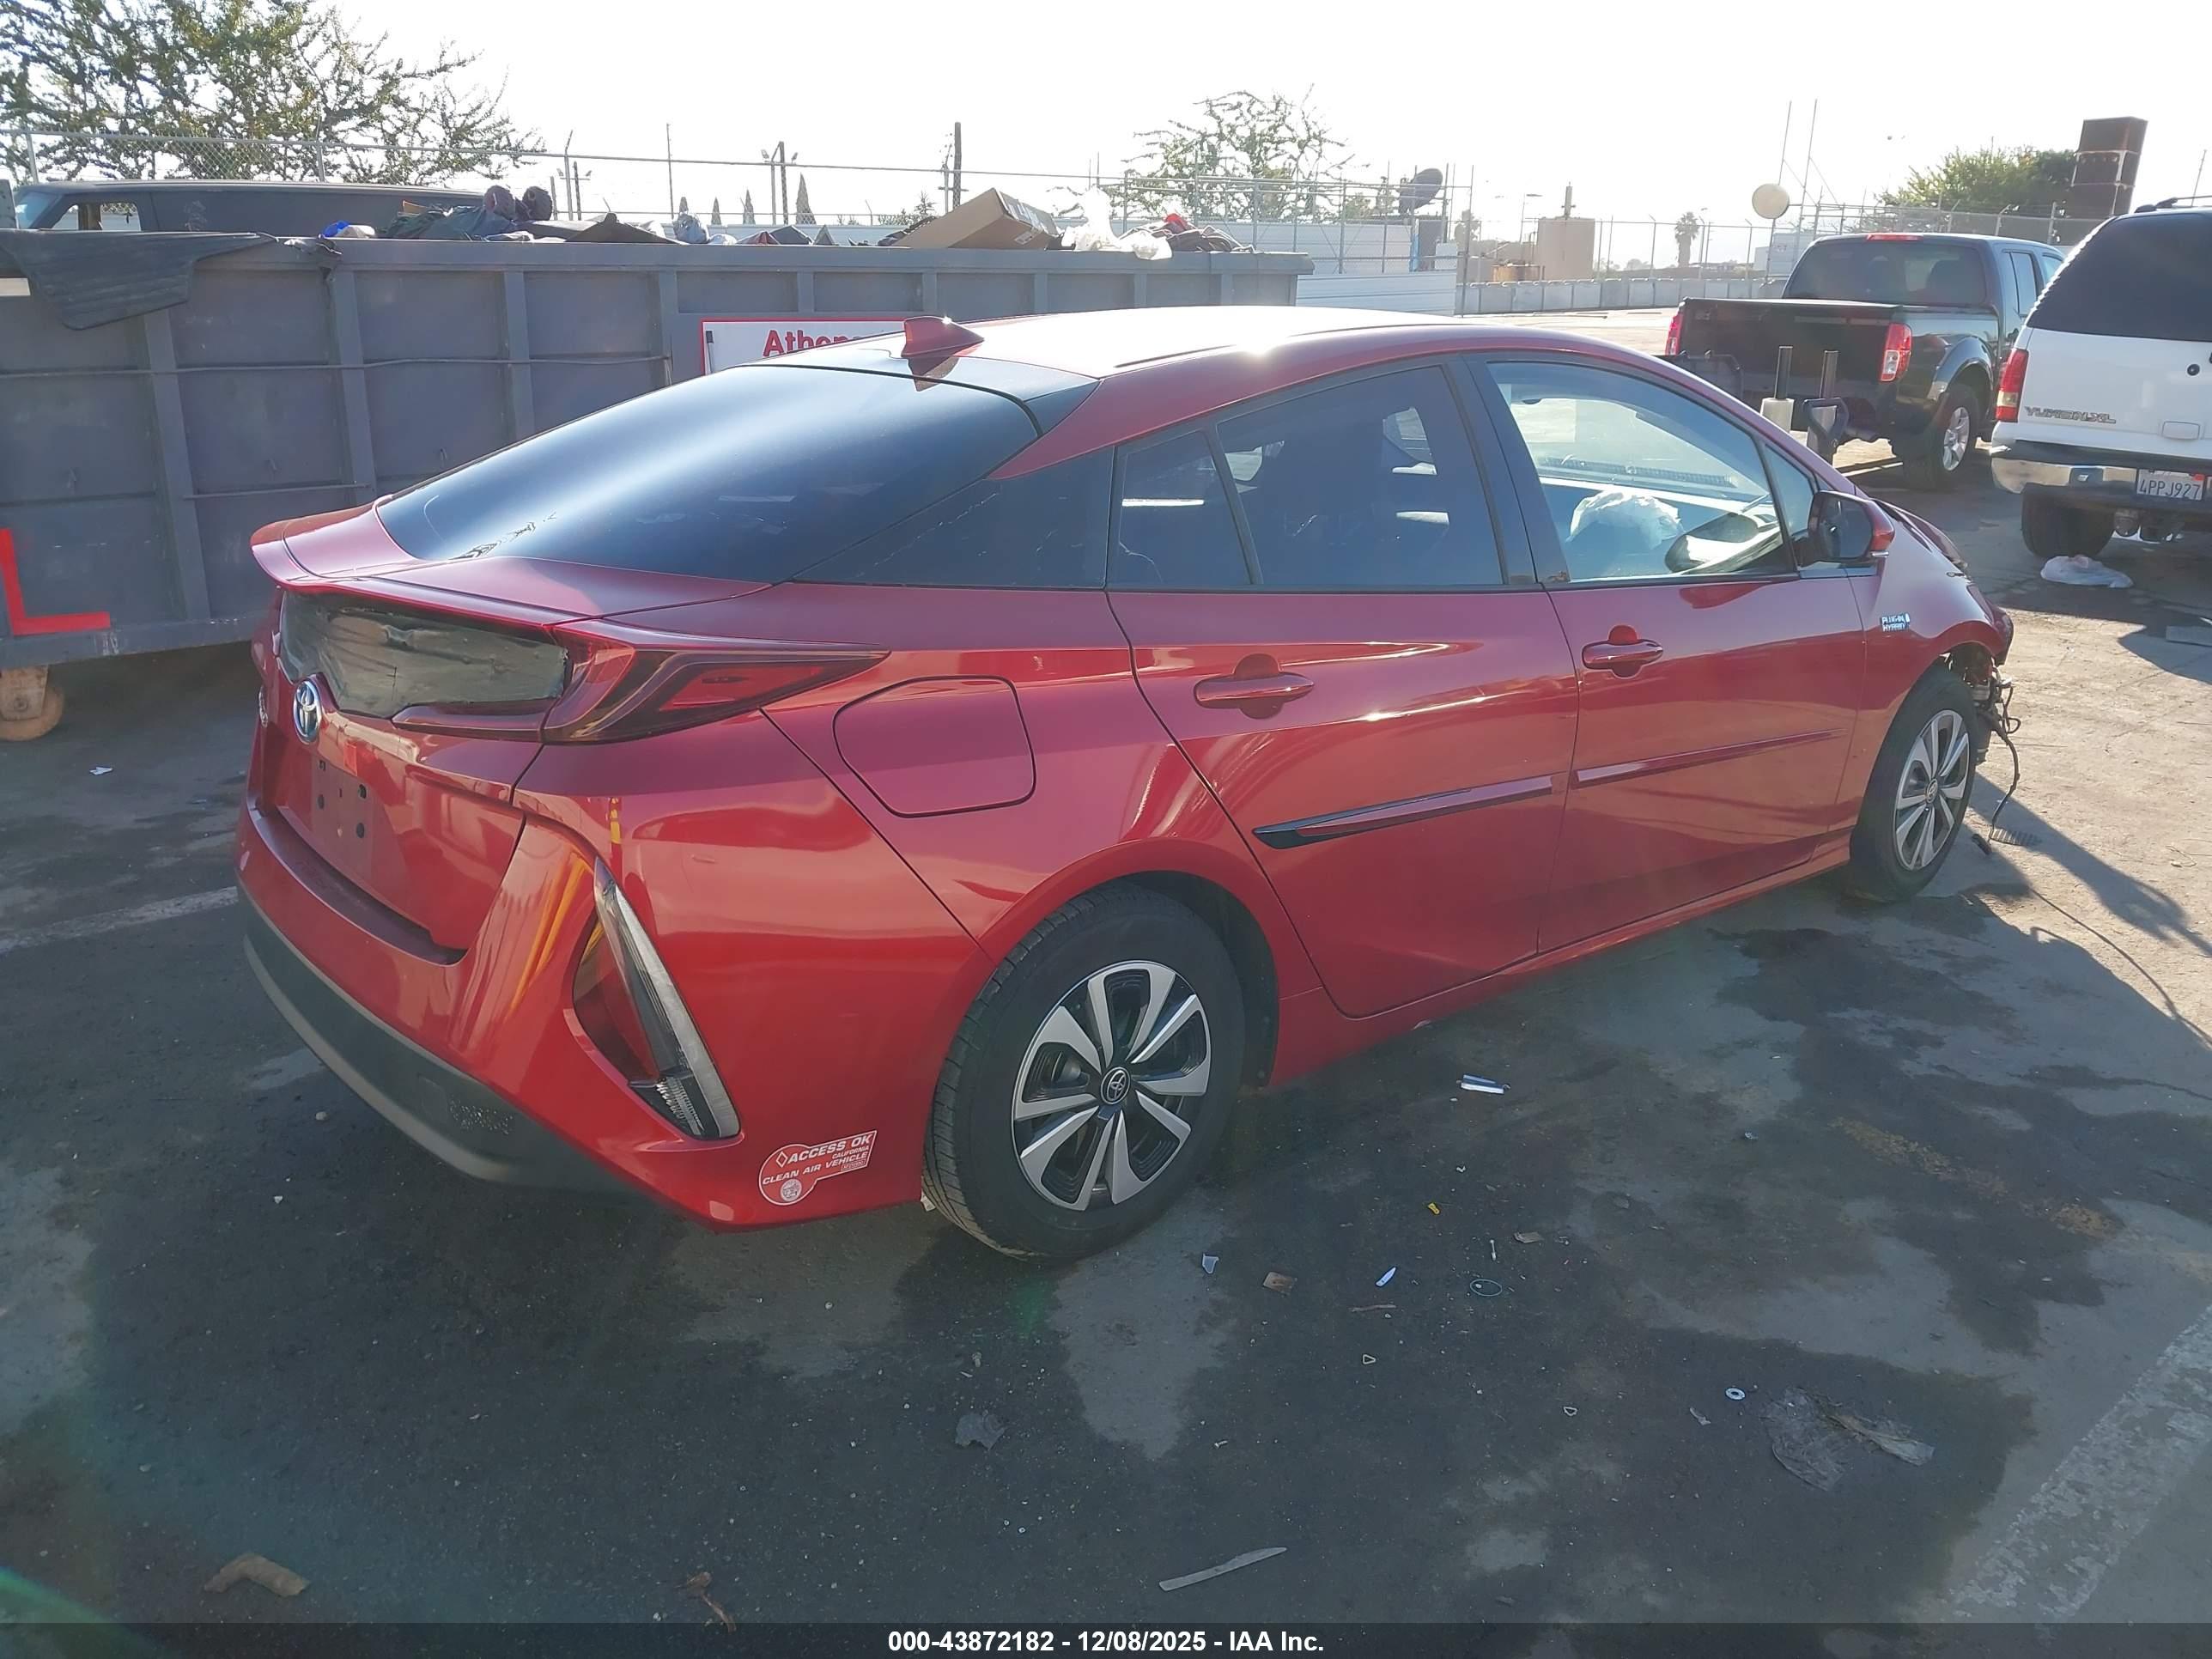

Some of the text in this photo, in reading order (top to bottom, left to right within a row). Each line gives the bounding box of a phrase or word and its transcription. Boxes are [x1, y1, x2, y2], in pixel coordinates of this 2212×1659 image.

[2139, 479, 2202, 500] 4PPJ927
[787, 1133, 873, 1164] ACCESS OK
[832, 1146, 870, 1160] CALIFORNIA
[763, 1170, 800, 1185] CLEAN
[802, 1164, 822, 1175] AIR
[825, 1152, 869, 1169] VEHICLE
